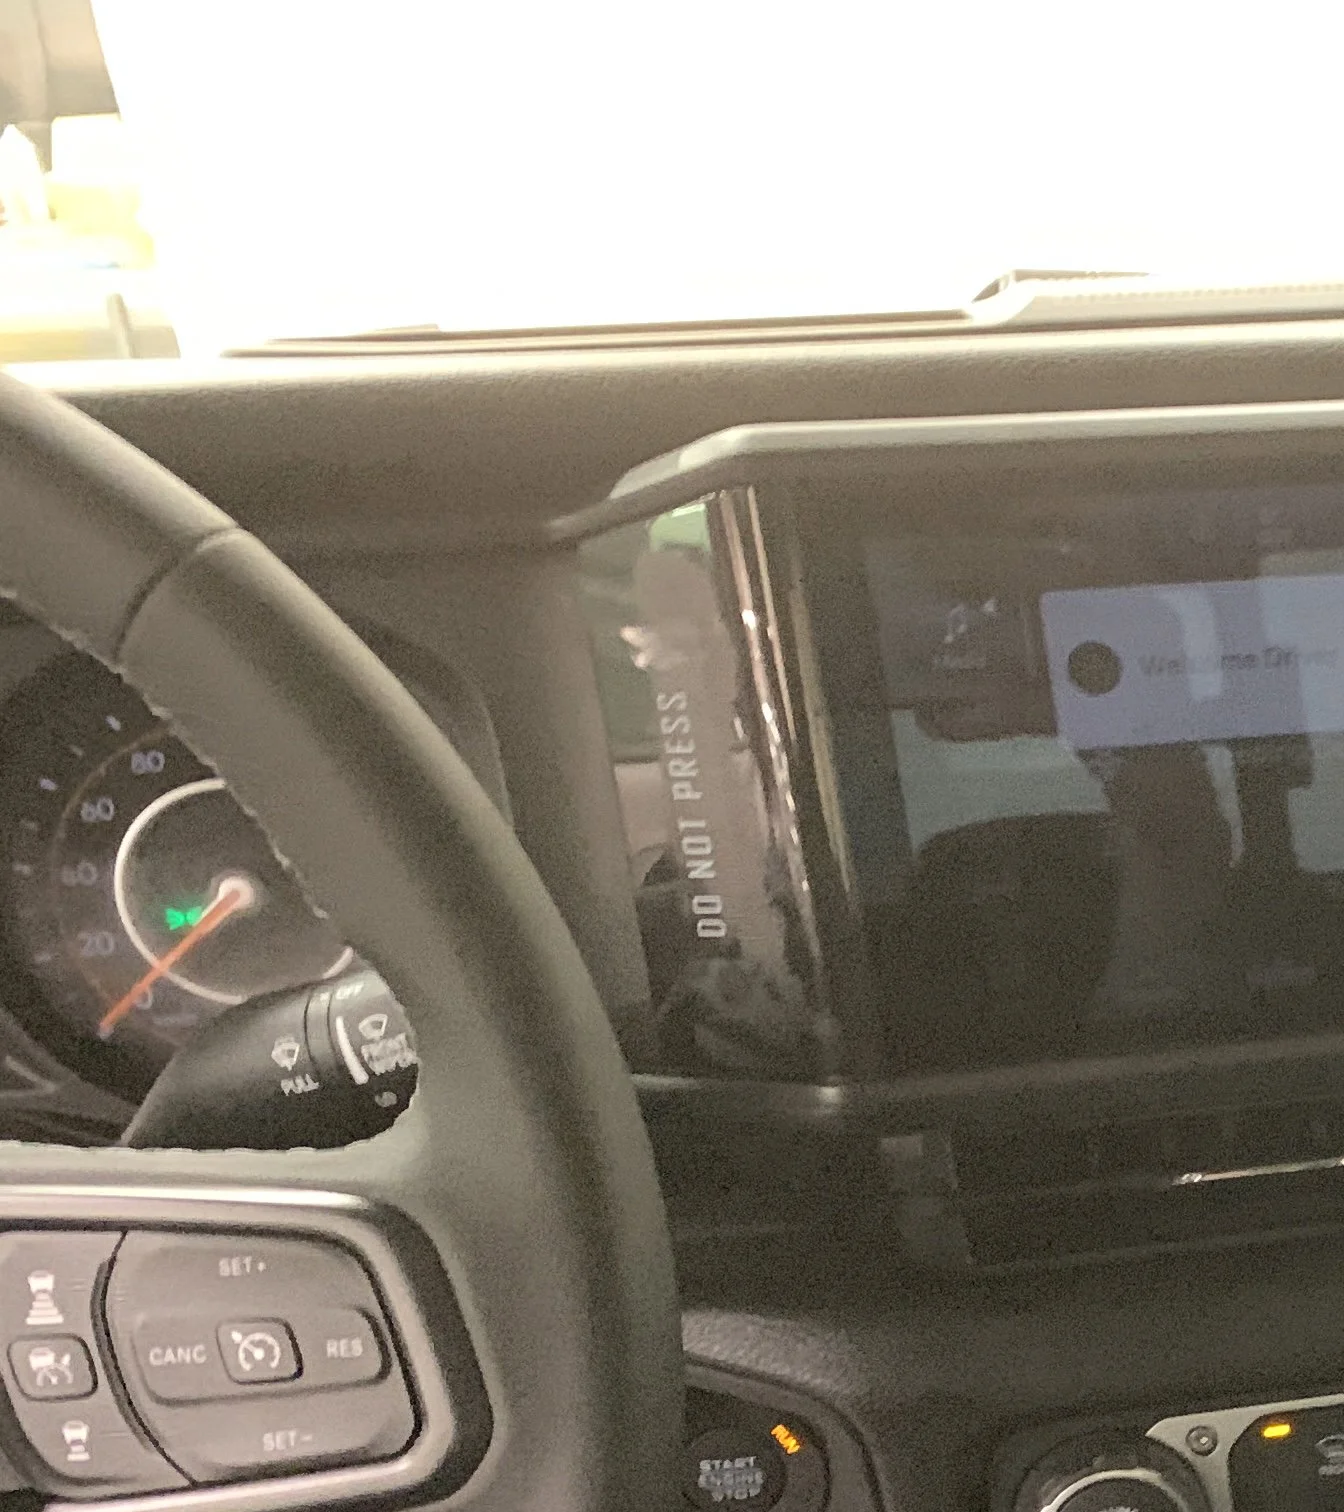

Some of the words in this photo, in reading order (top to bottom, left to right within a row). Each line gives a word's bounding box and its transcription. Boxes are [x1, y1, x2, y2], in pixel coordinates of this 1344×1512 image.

[655, 690, 703, 801] PRESS
[676, 816, 717, 879] NOT
[691, 894, 728, 938] DO
[149, 1344, 207, 1367] CANC
[326, 1337, 363, 1359] RES
[699, 1455, 757, 1471] START
